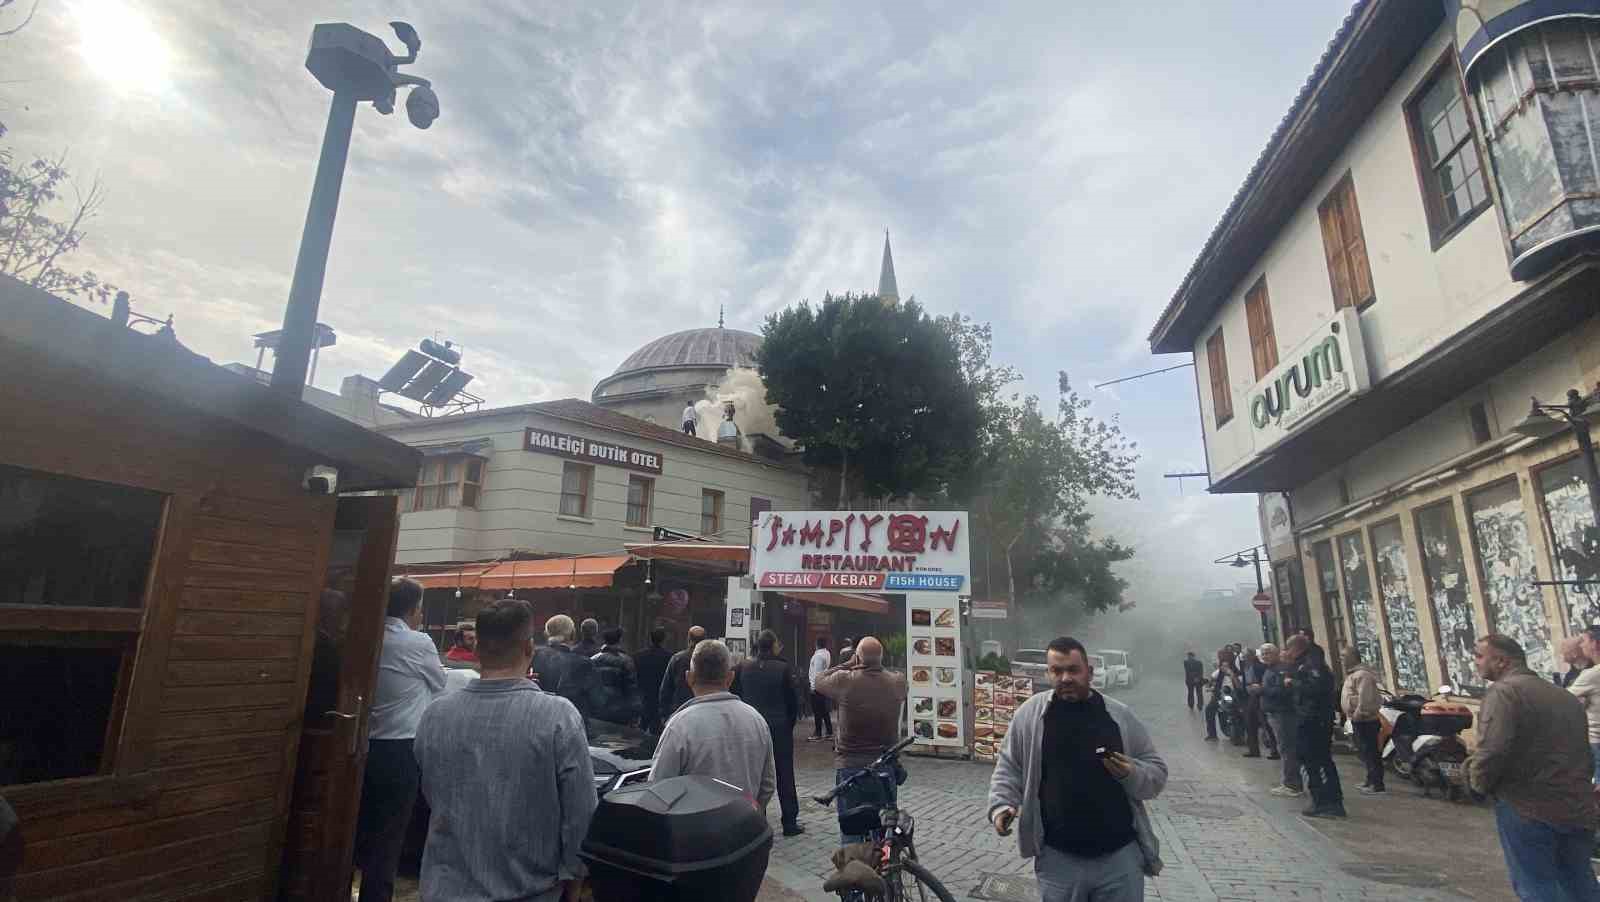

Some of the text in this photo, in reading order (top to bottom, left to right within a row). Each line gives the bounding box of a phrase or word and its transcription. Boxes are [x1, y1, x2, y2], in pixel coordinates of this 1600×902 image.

[530, 431, 660, 469] KALEİÇİ BUTİK OTEL
[801, 553, 917, 572] RESTAURANT
[768, 573, 958, 587] STEAK KEBAP FISH HOUSE
